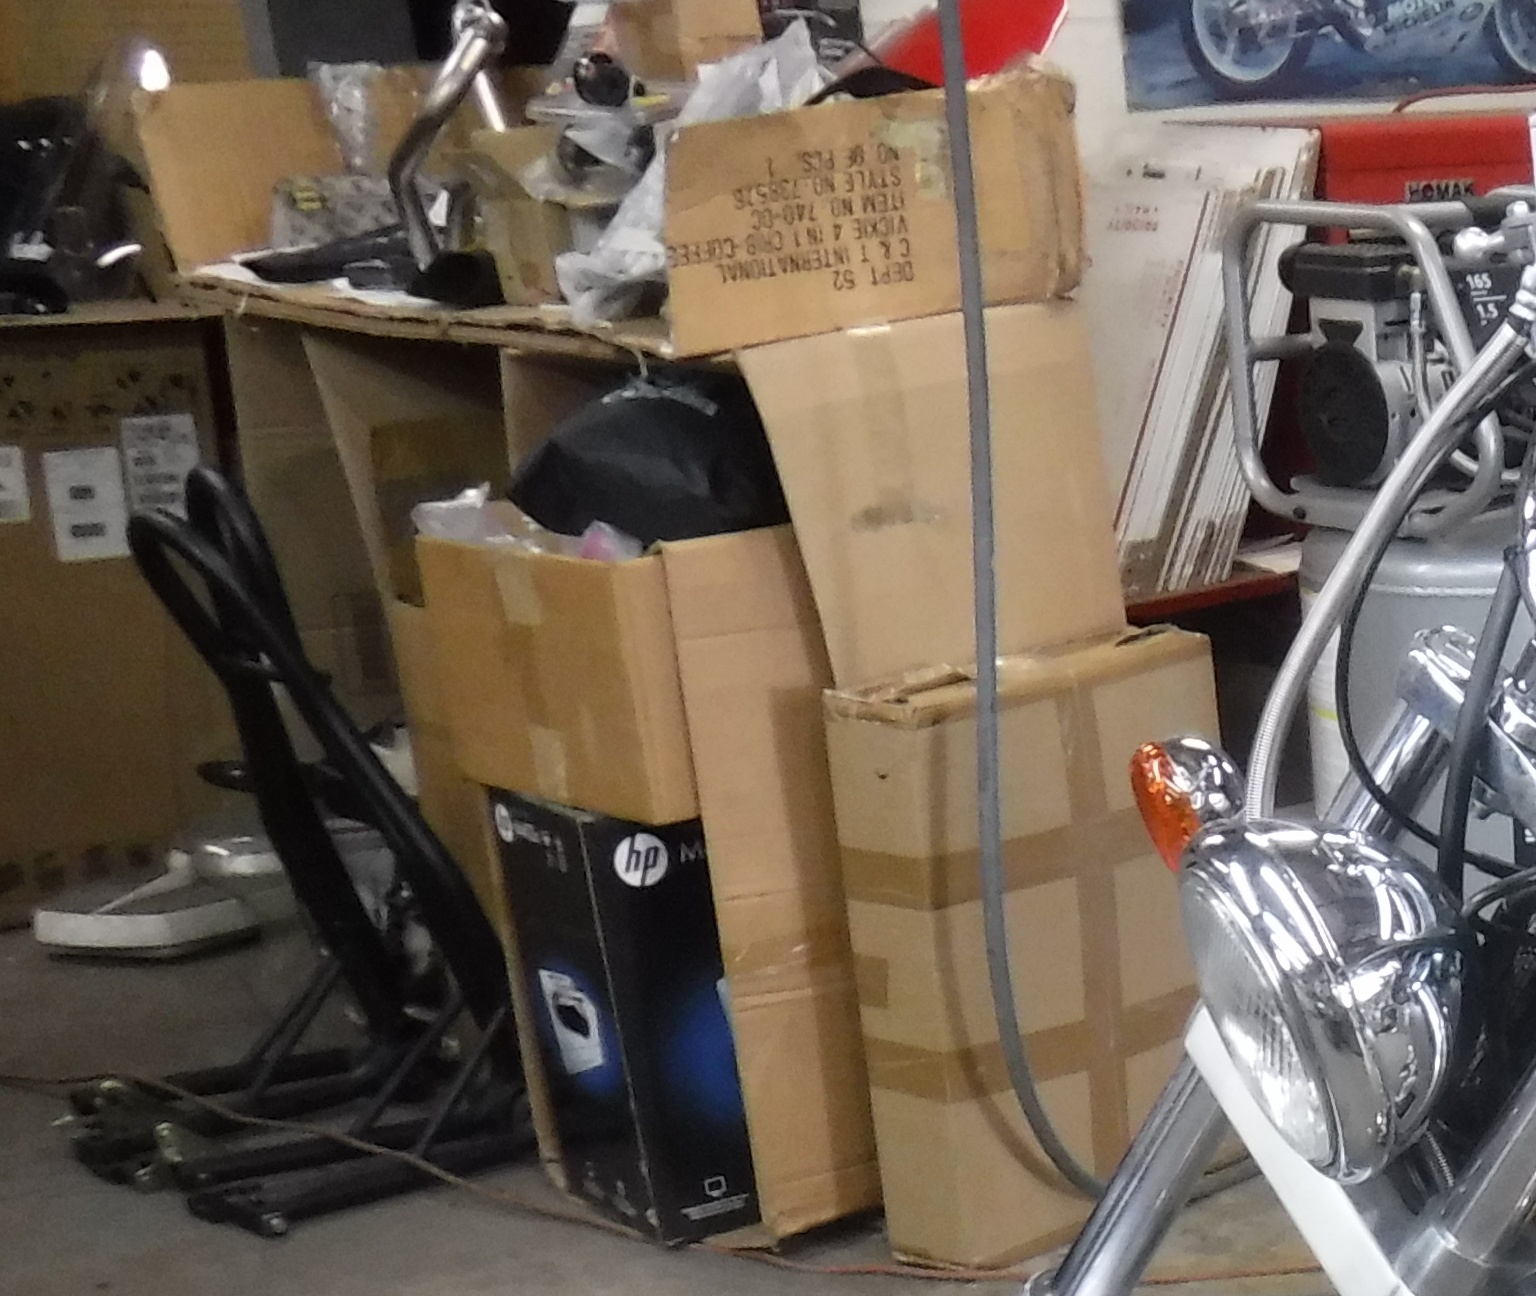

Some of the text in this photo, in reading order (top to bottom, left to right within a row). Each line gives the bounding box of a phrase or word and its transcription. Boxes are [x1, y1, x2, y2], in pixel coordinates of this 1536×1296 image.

[844, 167, 901, 193] STYLE
[862, 191, 904, 214] ITEM
[834, 224, 842, 241] 4
[900, 238, 909, 258] C
[716, 248, 849, 284] INTERNATIONAL
[834, 261, 914, 291] DEPT 52
